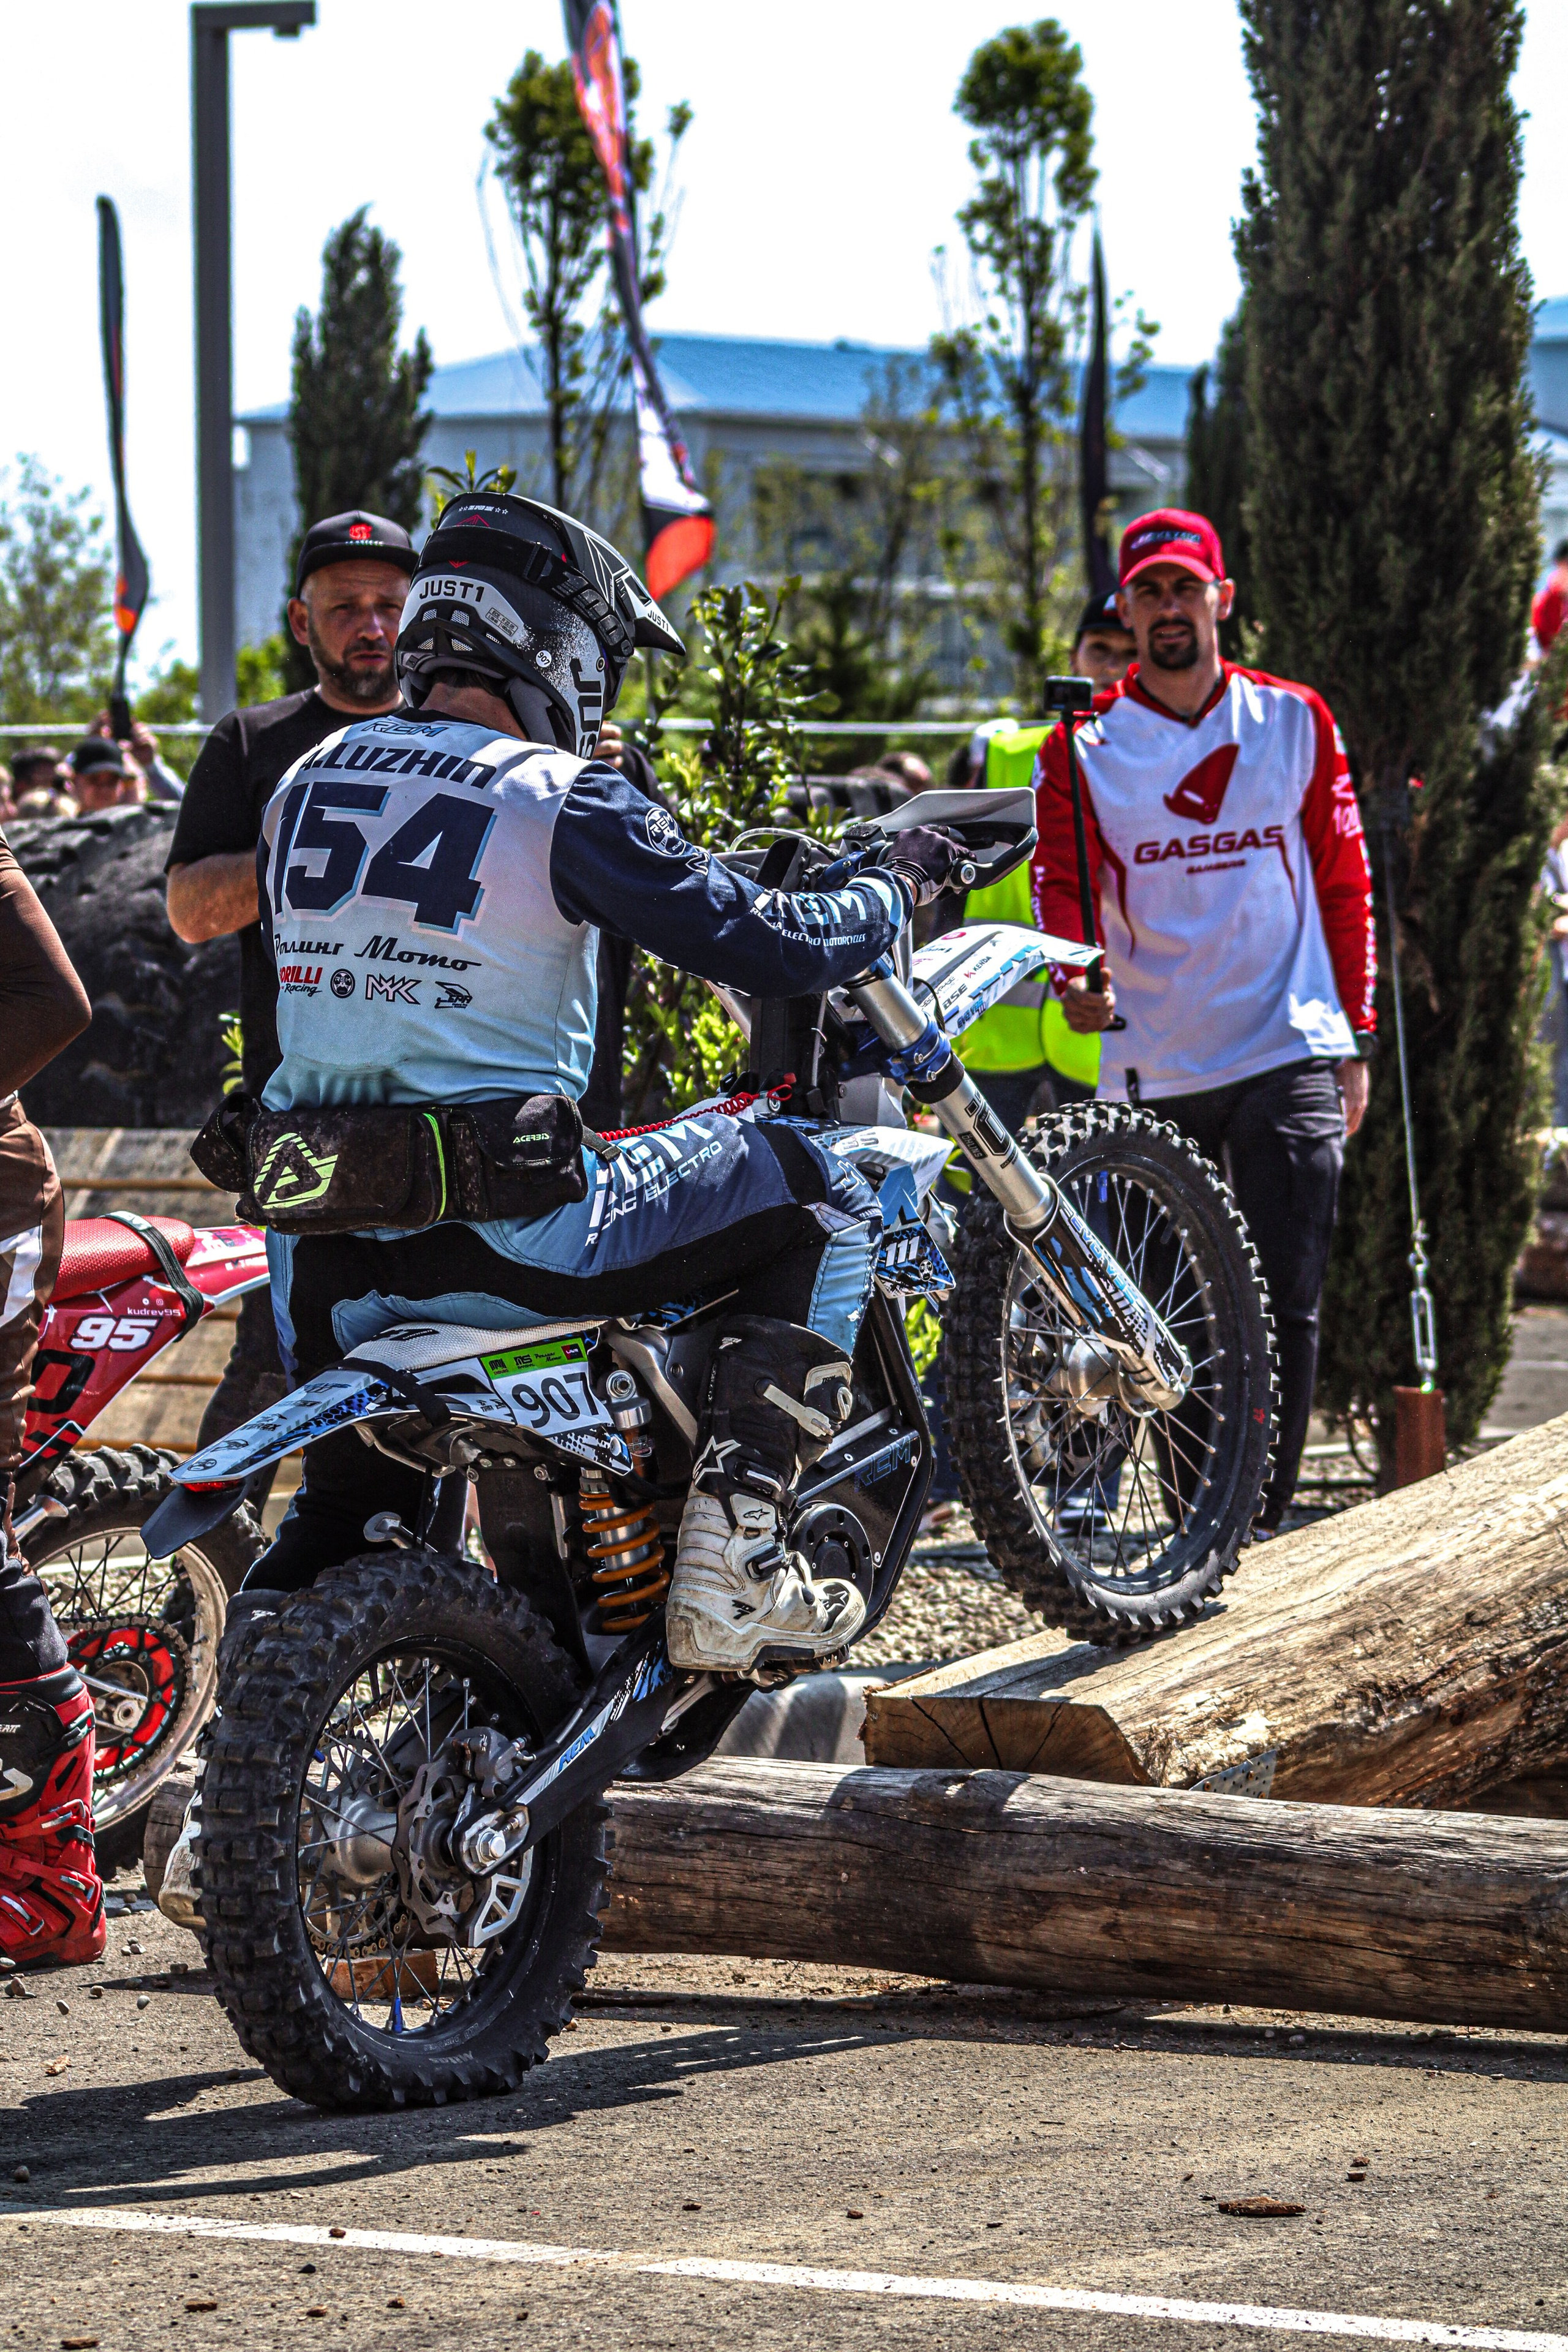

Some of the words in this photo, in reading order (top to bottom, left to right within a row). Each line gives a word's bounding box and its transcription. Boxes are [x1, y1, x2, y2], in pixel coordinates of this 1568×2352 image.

[419, 579, 485, 603] JUST1
[647, 610, 669, 632] JUST1
[537, 652, 551, 665] 907
[649, 813, 673, 837] REM
[274, 781, 497, 932] 154
[1134, 824, 1284, 865] GASGAS
[354, 935, 482, 971] Мото
[973, 956, 992, 971] KENDA
[284, 984, 323, 997] Racing
[513, 1133, 550, 1144] ACERBIS
[962, 1134, 983, 1158] ÖHLINS
[585, 1195, 637, 1247] RCING
[646, 1140, 723, 1203] ELECTRO
[884, 1235, 920, 1267] 111
[127, 1307, 181, 1317] kudrev95
[68, 1315, 161, 1351] 95
[511, 1372, 600, 1429] 907
[854, 1435, 911, 1493] REM
[557, 1727, 596, 1774] REM
